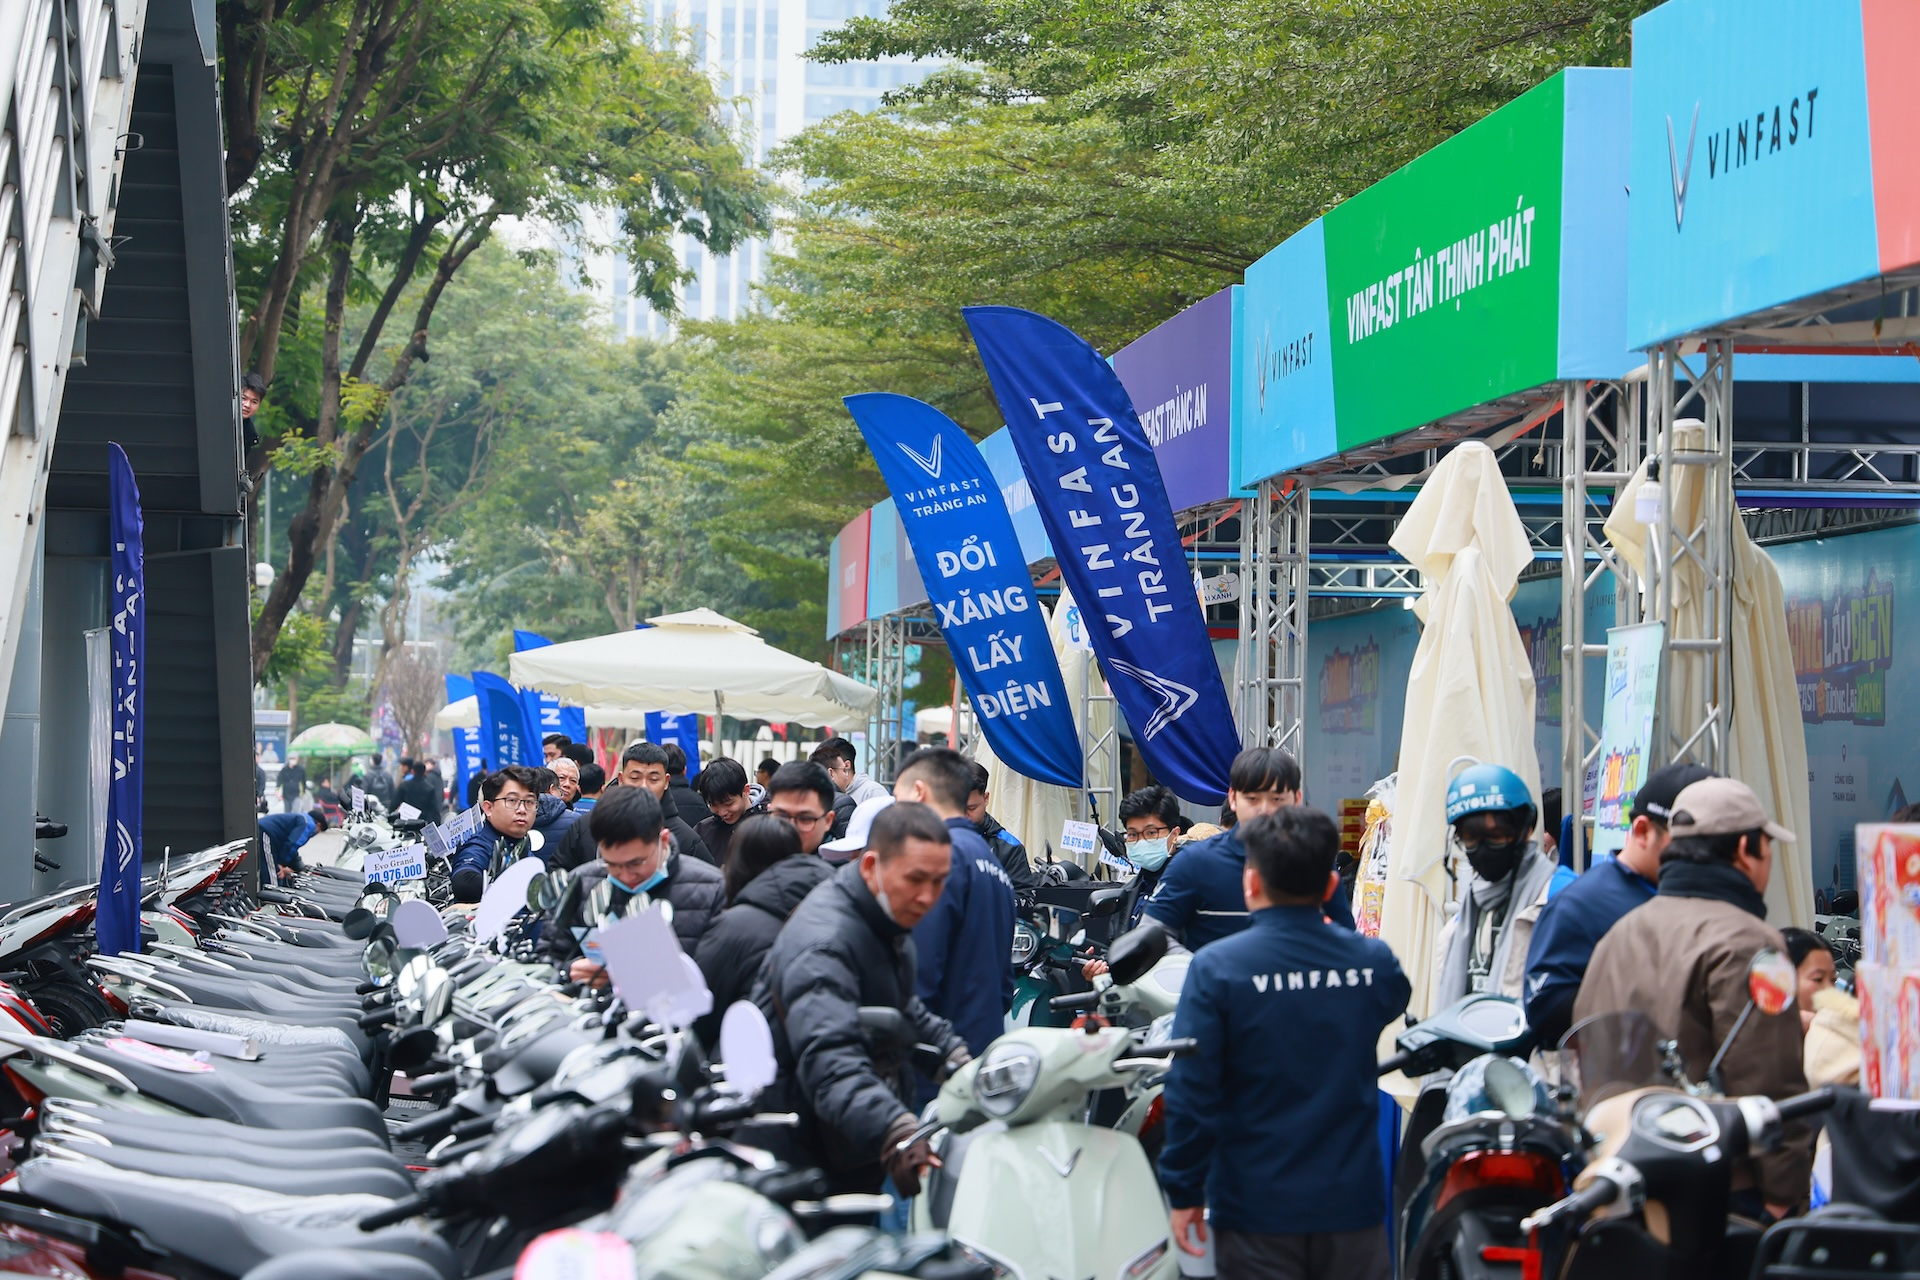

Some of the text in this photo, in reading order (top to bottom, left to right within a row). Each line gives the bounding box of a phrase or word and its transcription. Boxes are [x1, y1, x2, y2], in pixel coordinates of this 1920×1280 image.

[1708, 86, 1818, 179] VINFAST
[1346, 194, 1536, 345] VINFAST TÂN THỊNH PHÁT
[1271, 331, 1314, 382] VINFAST
[1165, 384, 1194, 442] TRÀNG
[1194, 382, 1208, 430] AN
[904, 477, 982, 503] VINFAST
[912, 496, 965, 518] TRÀNG
[966, 493, 988, 507] AN
[1029, 397, 1134, 640] VINFAST
[1087, 417, 1174, 623] TRÀNG AN
[935, 534, 998, 579] ĐỔI
[934, 586, 1030, 630] XĂNG
[967, 629, 1023, 673] LẤY
[975, 679, 1052, 721] ĐIỆN
[374, 856, 415, 871] Evo Grand
[1062, 835, 1094, 850] 20.976.000
[368, 863, 422, 884] 20.976.000
[1251, 967, 1375, 994] VINFAST
